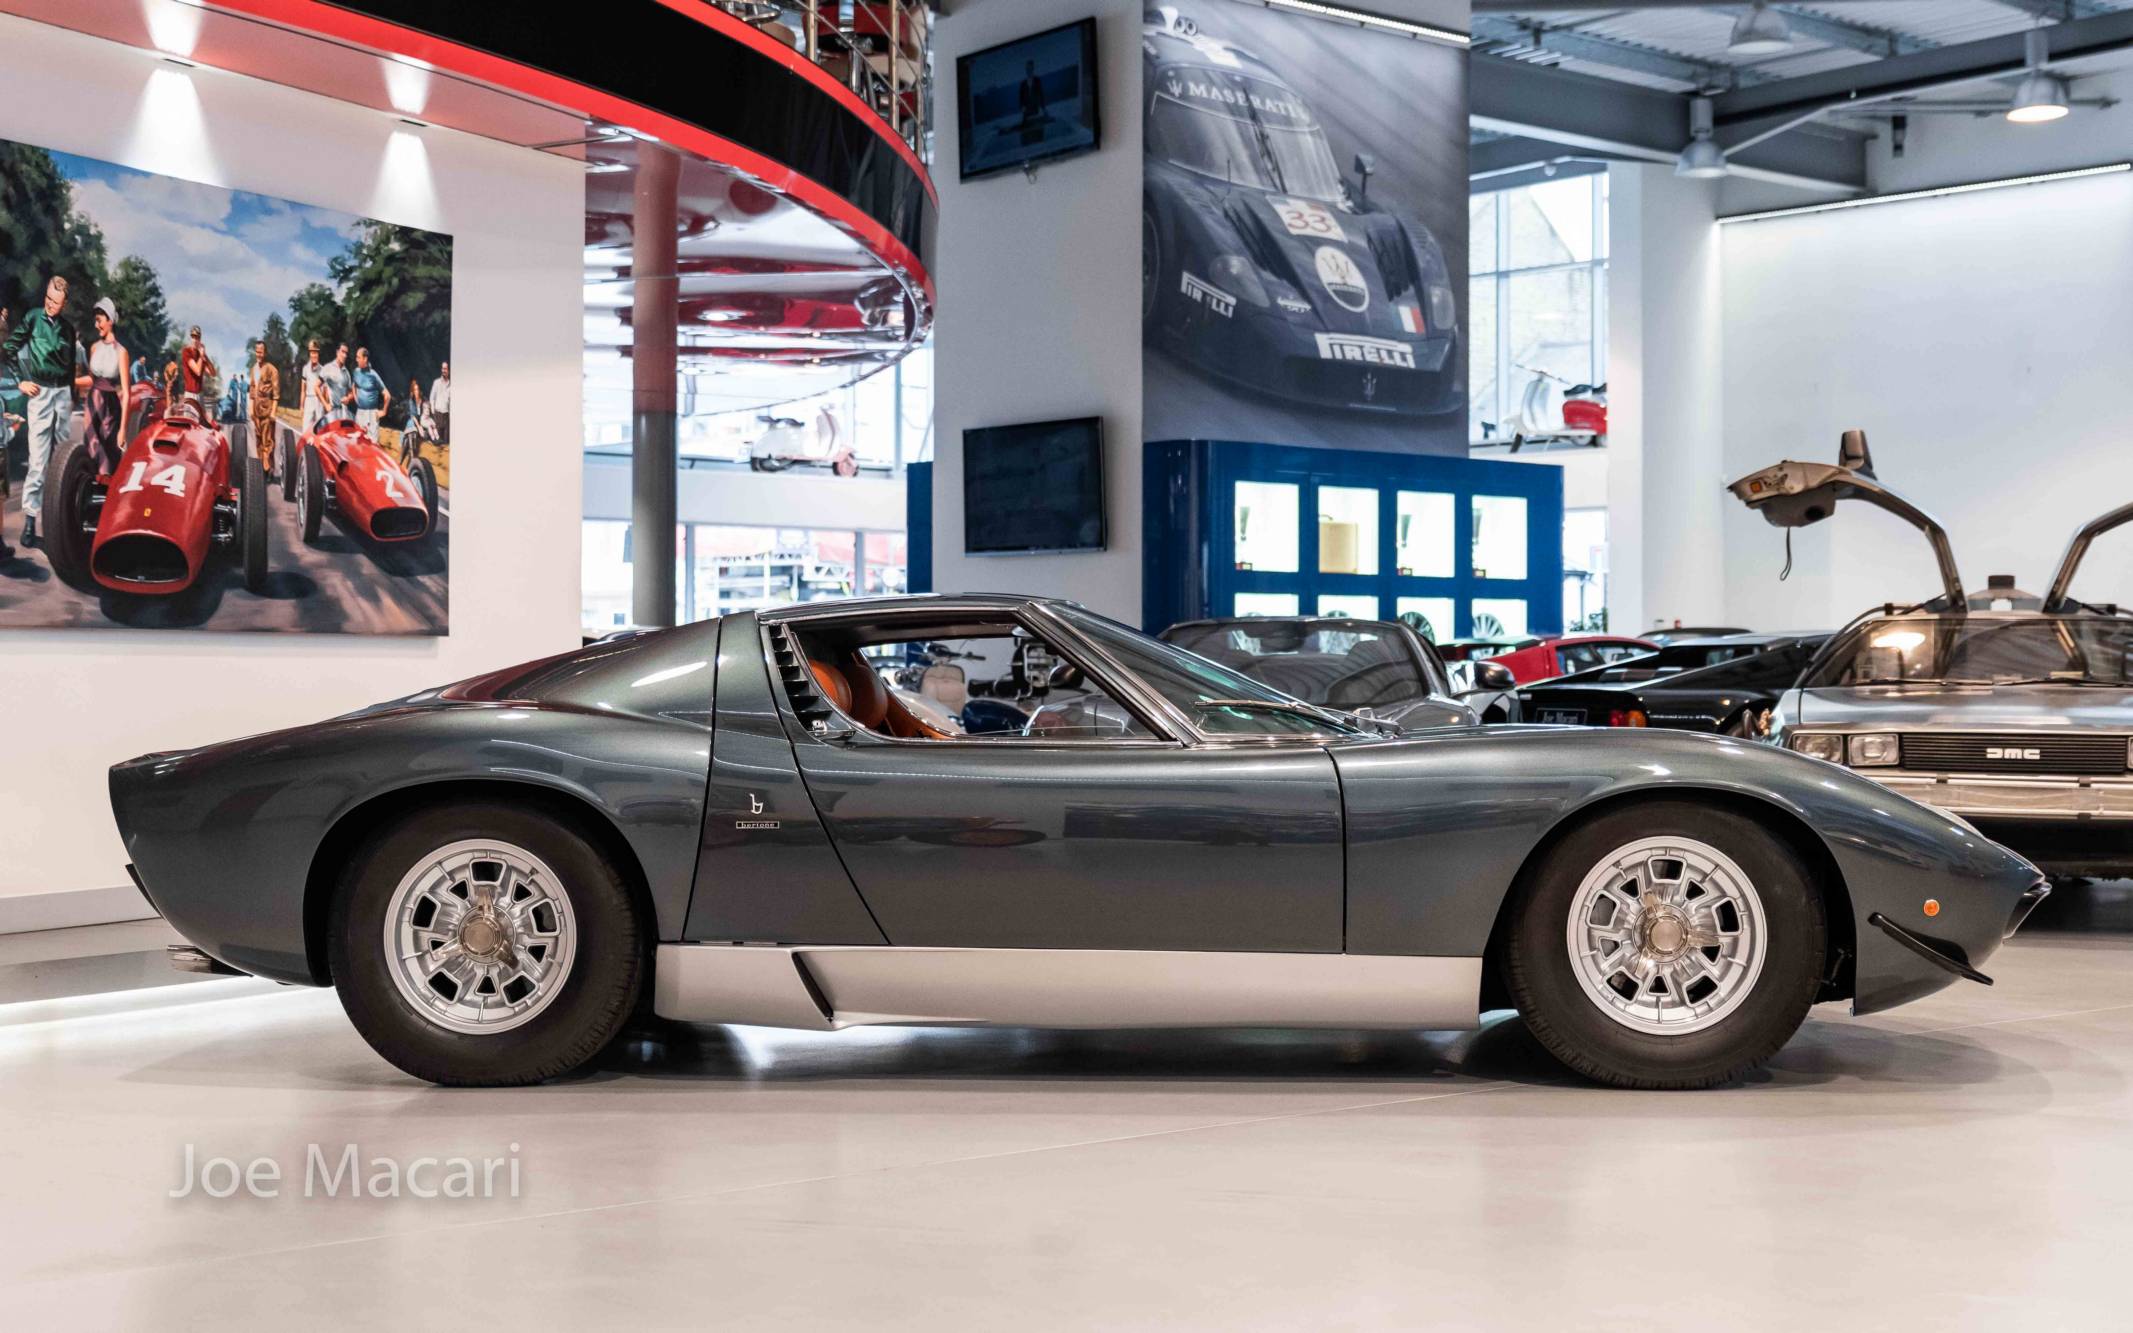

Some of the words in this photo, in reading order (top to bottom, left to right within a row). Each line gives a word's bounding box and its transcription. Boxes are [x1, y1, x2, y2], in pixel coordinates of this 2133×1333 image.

[1286, 210, 1332, 233] 33
[1181, 271, 1237, 319] PIRLLI
[1314, 332, 1416, 369] PIRELLI
[119, 461, 187, 498] 14
[376, 470, 404, 498] 2
[1986, 748, 2041, 760] DMC
